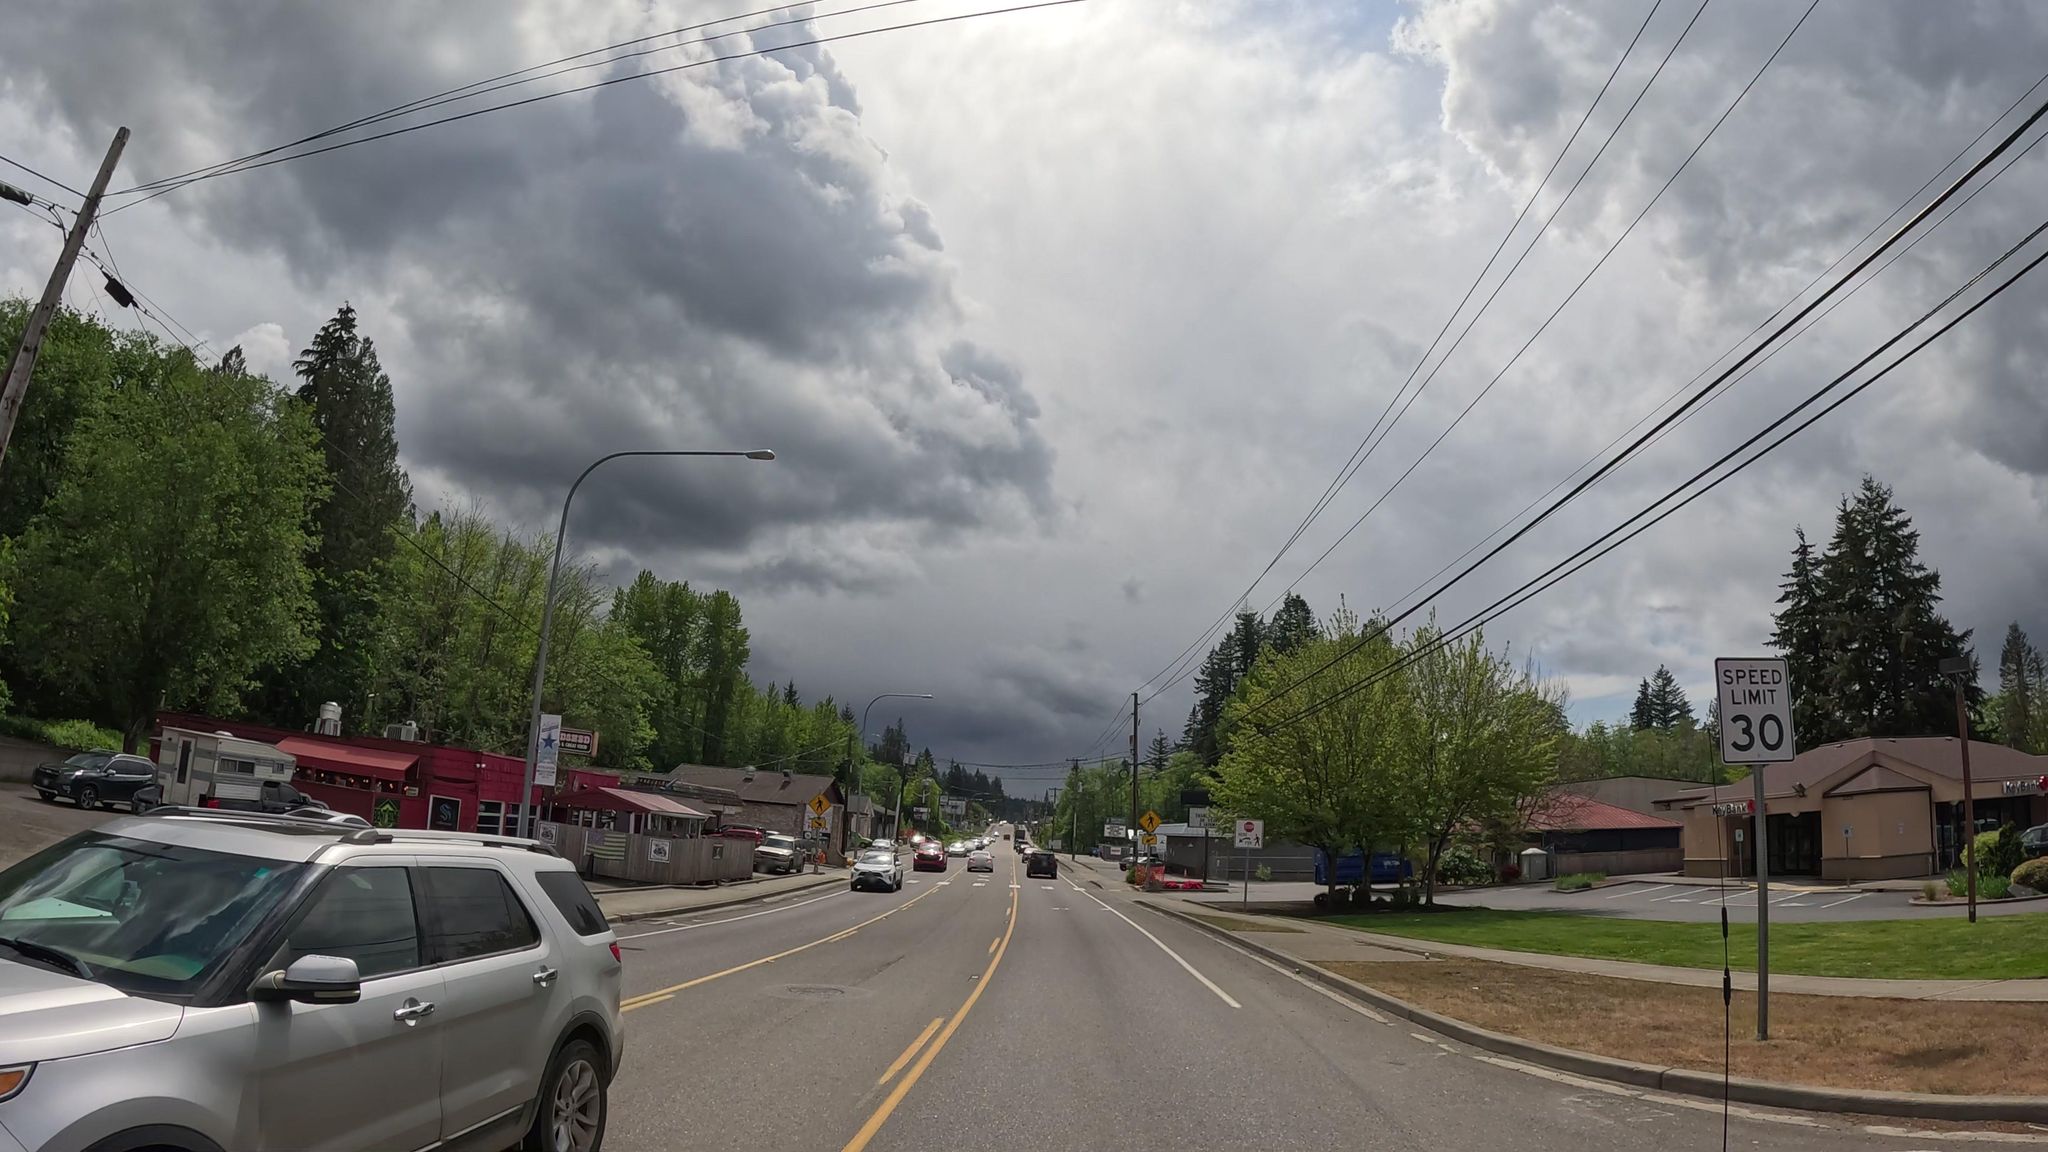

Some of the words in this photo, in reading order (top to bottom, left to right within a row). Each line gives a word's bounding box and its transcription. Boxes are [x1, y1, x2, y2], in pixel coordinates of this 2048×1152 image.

[1723, 669, 1782, 685] SPEED
[1731, 689, 1777, 705] LIMIT
[1730, 713, 1784, 752] 30
[2003, 780, 2040, 794] KeyBank
[1712, 802, 1747, 817] KeyBank
